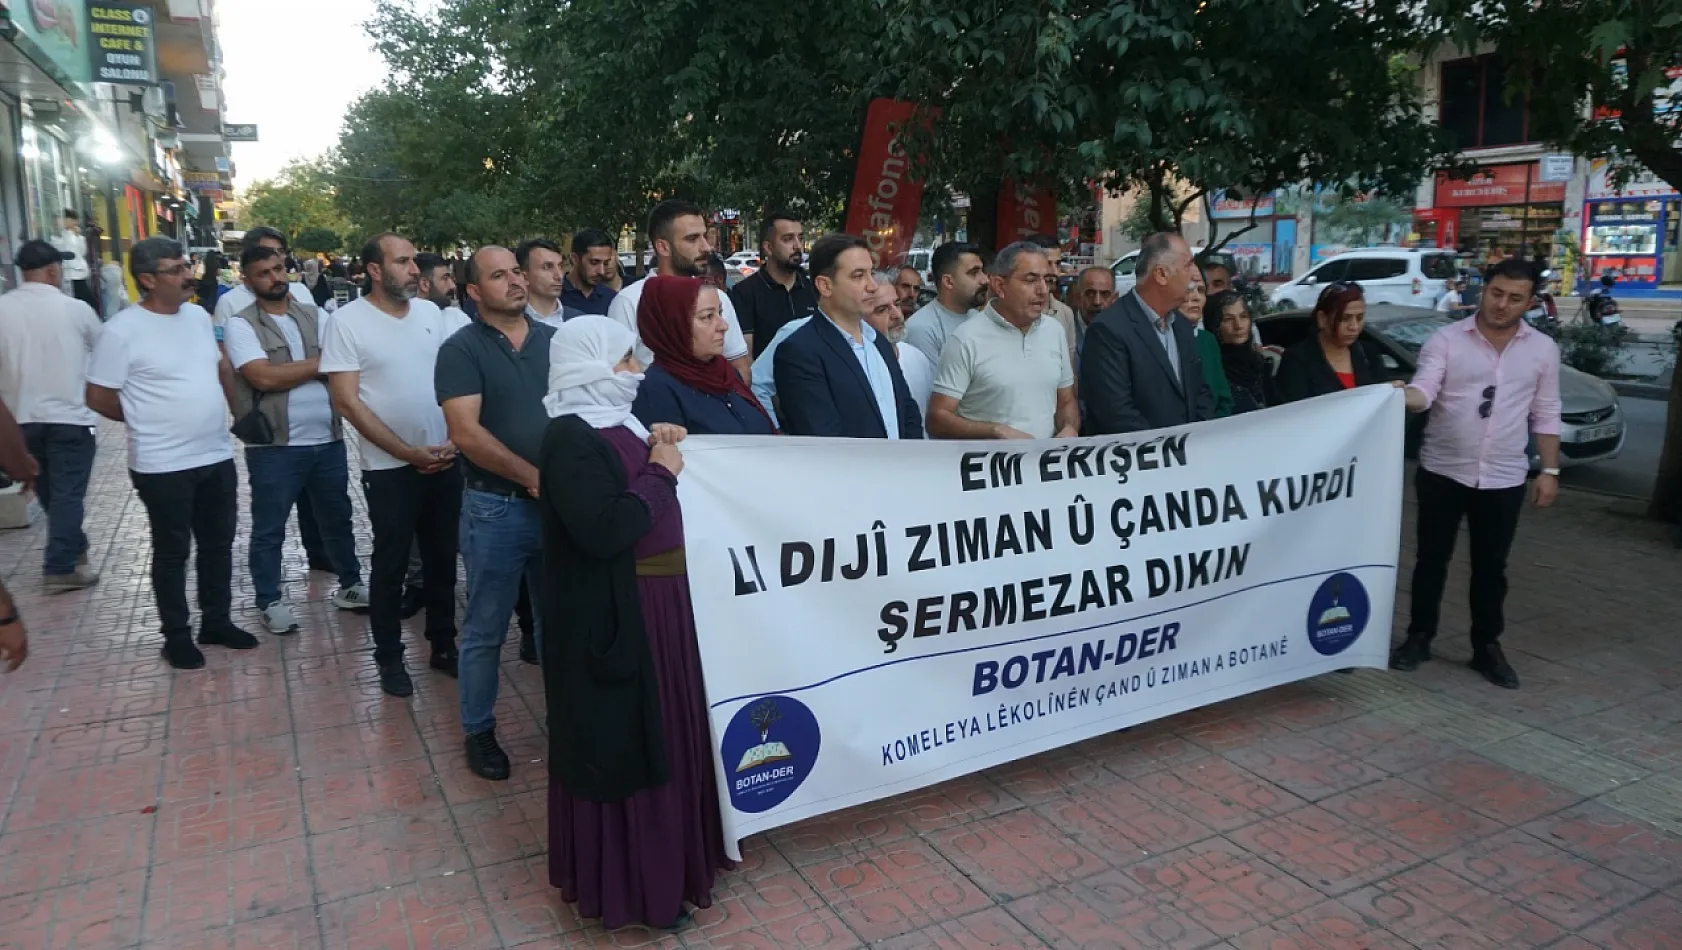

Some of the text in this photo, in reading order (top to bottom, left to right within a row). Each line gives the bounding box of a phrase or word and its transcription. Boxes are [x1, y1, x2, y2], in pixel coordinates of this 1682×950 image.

[91, 7, 132, 21] CLASS
[91, 23, 150, 37] INTERNET
[100, 37, 144, 51] CAFE &
[107, 52, 141, 67] OYUN
[100, 66, 150, 80] SALONU
[960, 451, 1027, 492] EM
[728, 456, 1359, 596] LI DIJÎ ZIMAN Û ÇANDA KURDÎ
[877, 542, 1252, 654] ŞERMEZAR DIKIN
[1316, 623, 1354, 638] BOTAN-DER
[972, 622, 1181, 697] BOTAN-DER
[882, 634, 1289, 767] KOMELEYA LÊKOLÎNÊN ÇAND Û ZIMAN A BOTANÊ
[736, 766, 794, 790] BOTAN-DER
